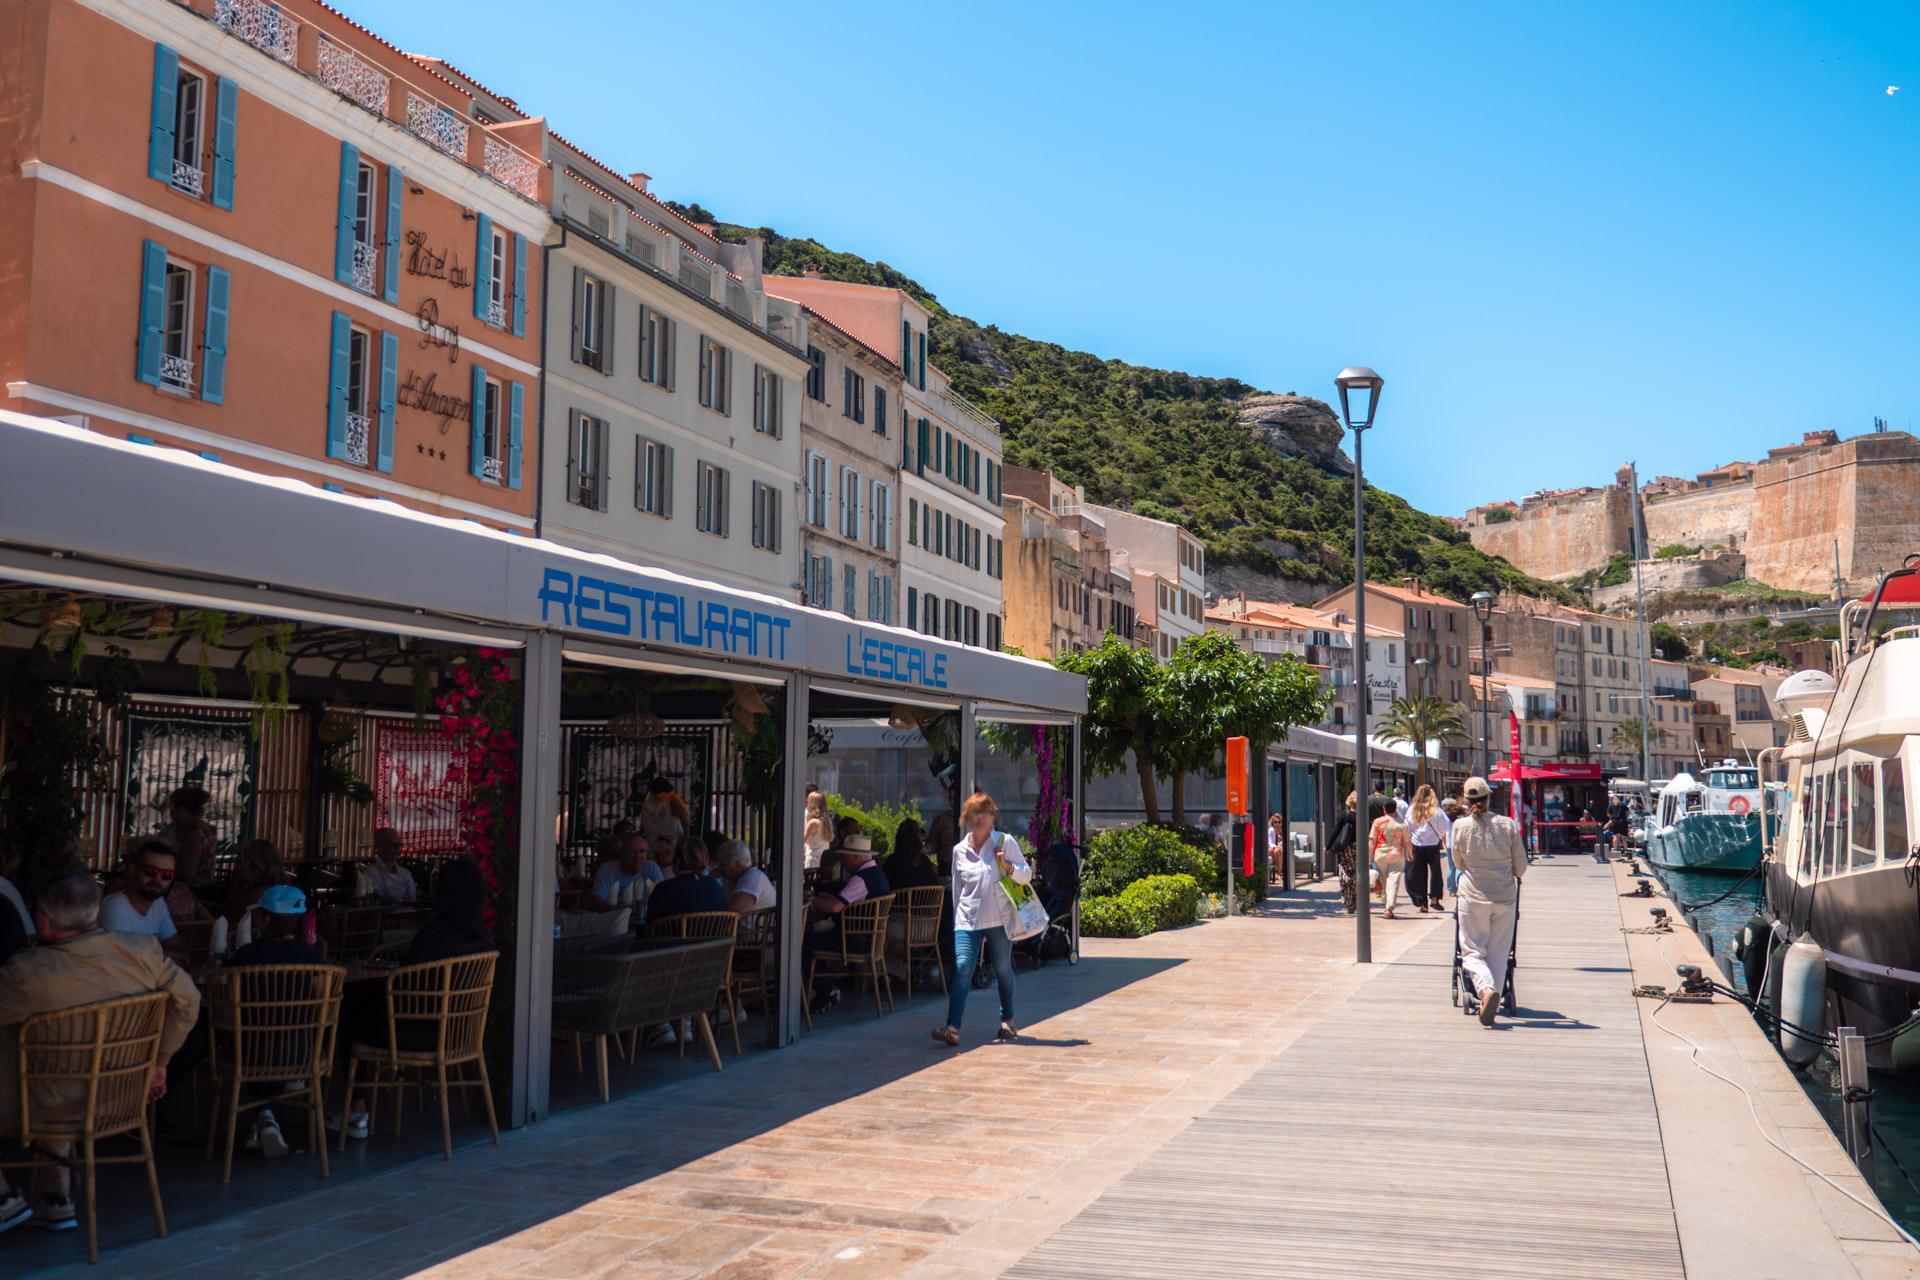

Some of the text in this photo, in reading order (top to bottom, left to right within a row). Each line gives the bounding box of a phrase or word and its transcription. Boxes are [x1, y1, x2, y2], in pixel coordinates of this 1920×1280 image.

[448, 252, 471, 288] du
[417, 298, 459, 364] Roy
[538, 567, 948, 689] RESTAURANT L'ESCALE
